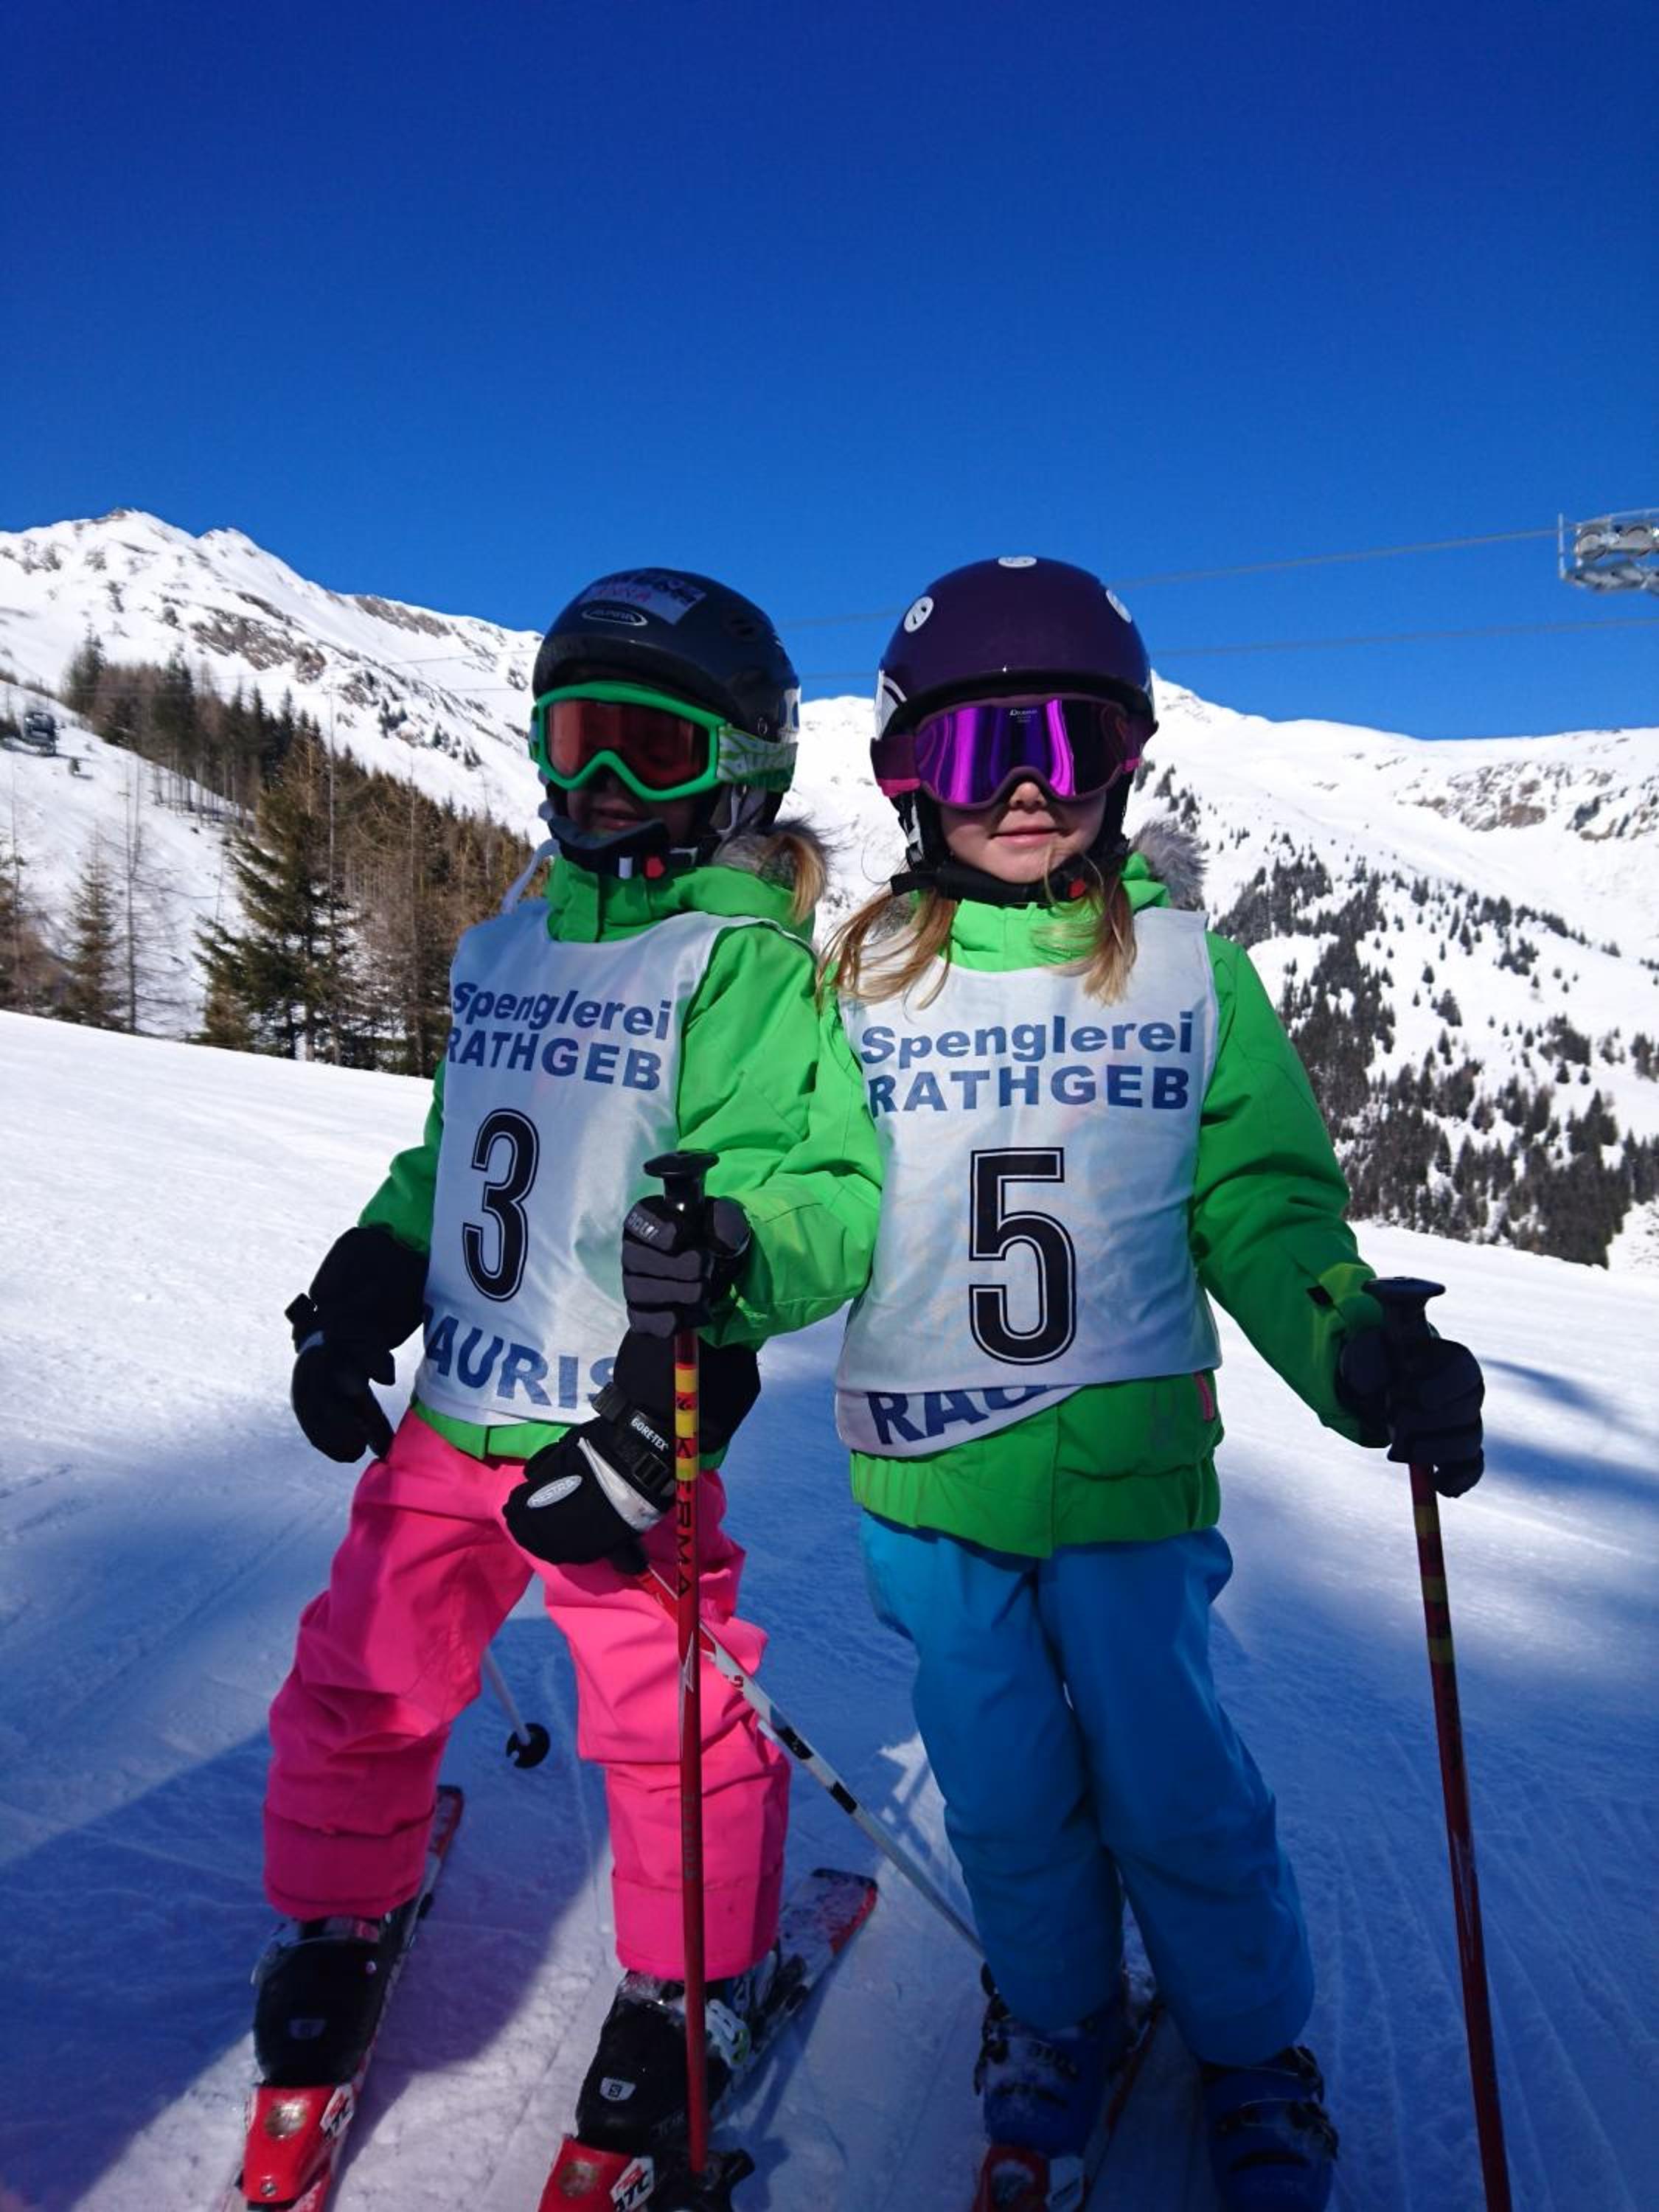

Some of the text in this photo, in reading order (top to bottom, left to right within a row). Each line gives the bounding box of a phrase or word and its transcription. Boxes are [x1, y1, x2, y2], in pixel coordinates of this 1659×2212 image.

[452, 981, 672, 1040] Spenglerei
[860, 1011, 1193, 1069] Spenglerei
[448, 1026, 662, 1091] RATHGEB
[868, 1064, 1189, 1119] RATHGEB
[462, 1107, 540, 1303] 3
[968, 1146, 1077, 1366] 5
[423, 1303, 619, 1410] AURI
